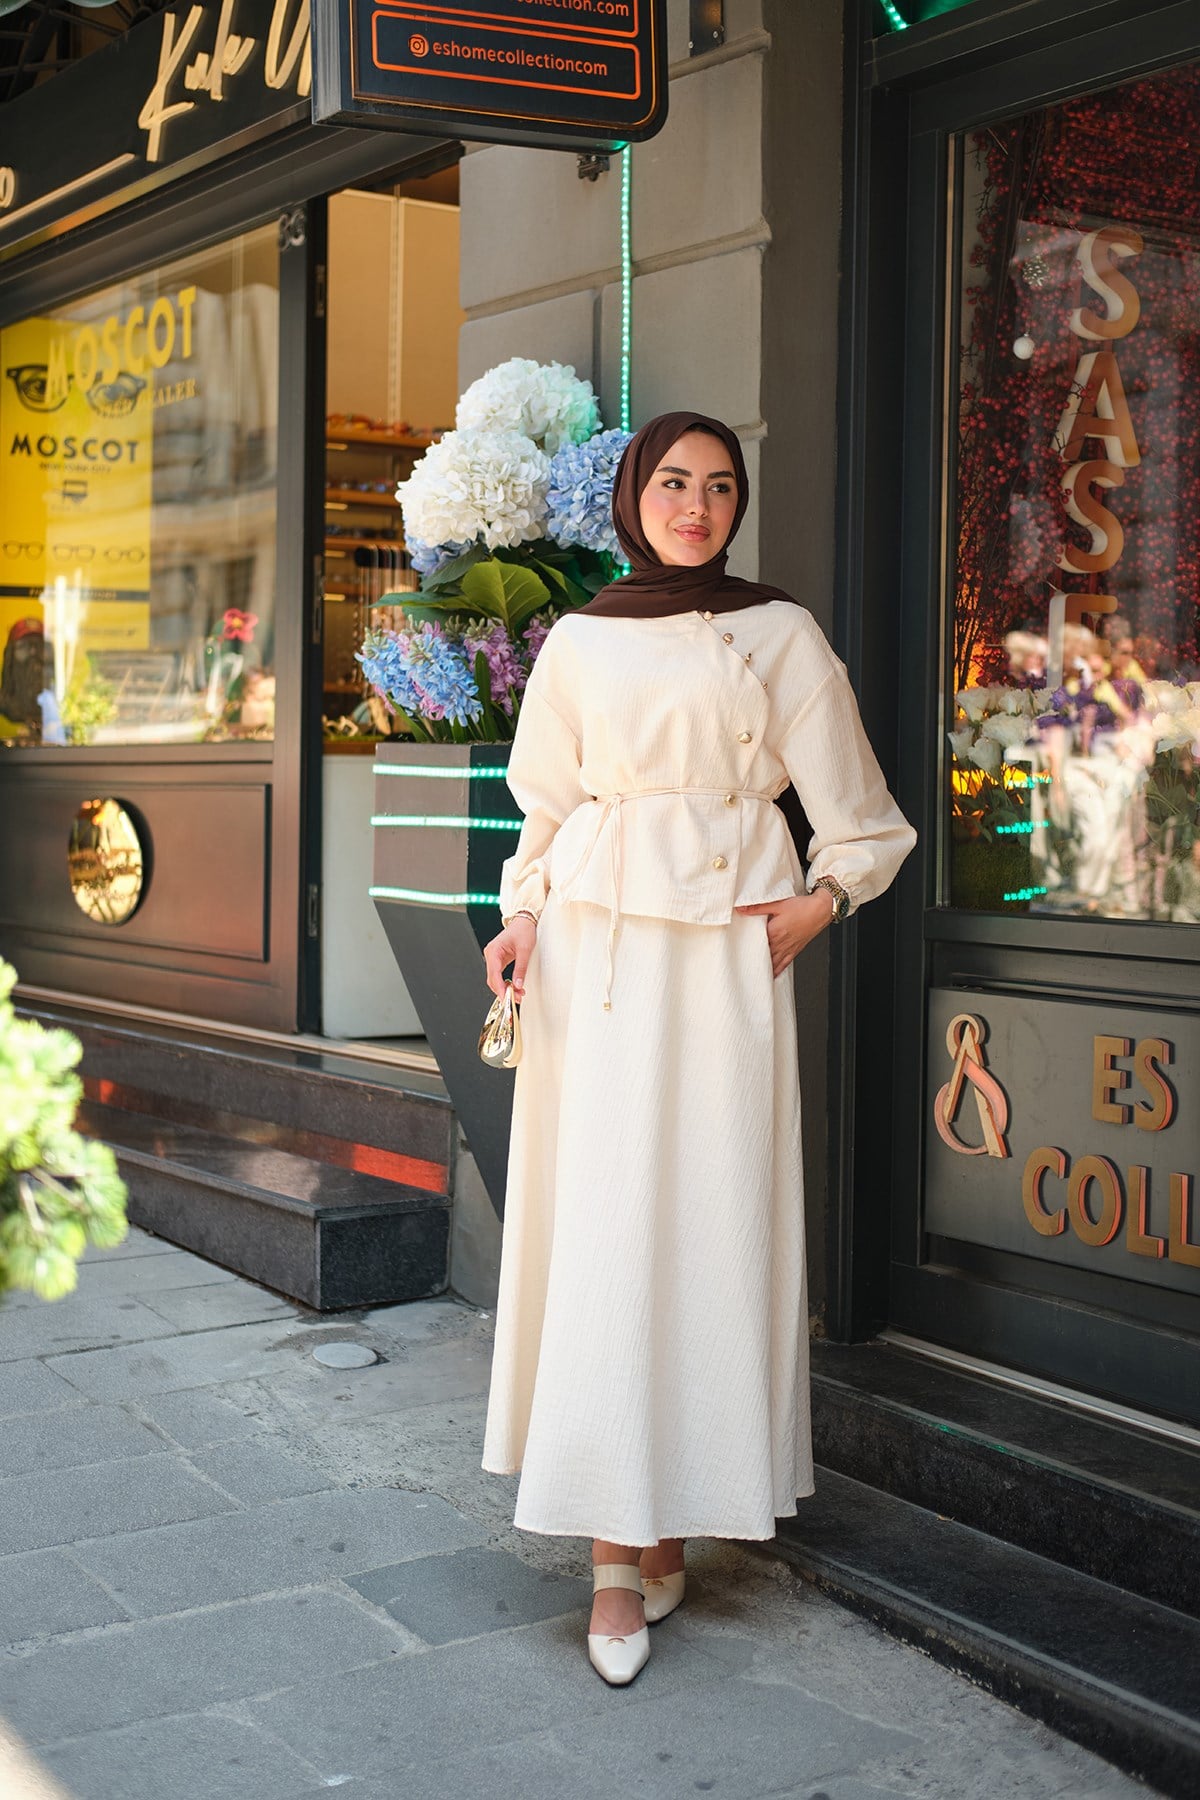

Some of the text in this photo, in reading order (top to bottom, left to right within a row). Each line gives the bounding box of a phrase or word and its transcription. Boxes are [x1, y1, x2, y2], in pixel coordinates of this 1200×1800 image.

[518, 0, 629, 16] ection.com
[433, 41, 608, 76] eshomecollectioncom
[46, 286, 197, 403] MOSCOT
[11, 433, 139, 462] MOSCOT
[1092, 1034, 1173, 1131] ES
[1022, 1146, 1200, 1268] COLL
